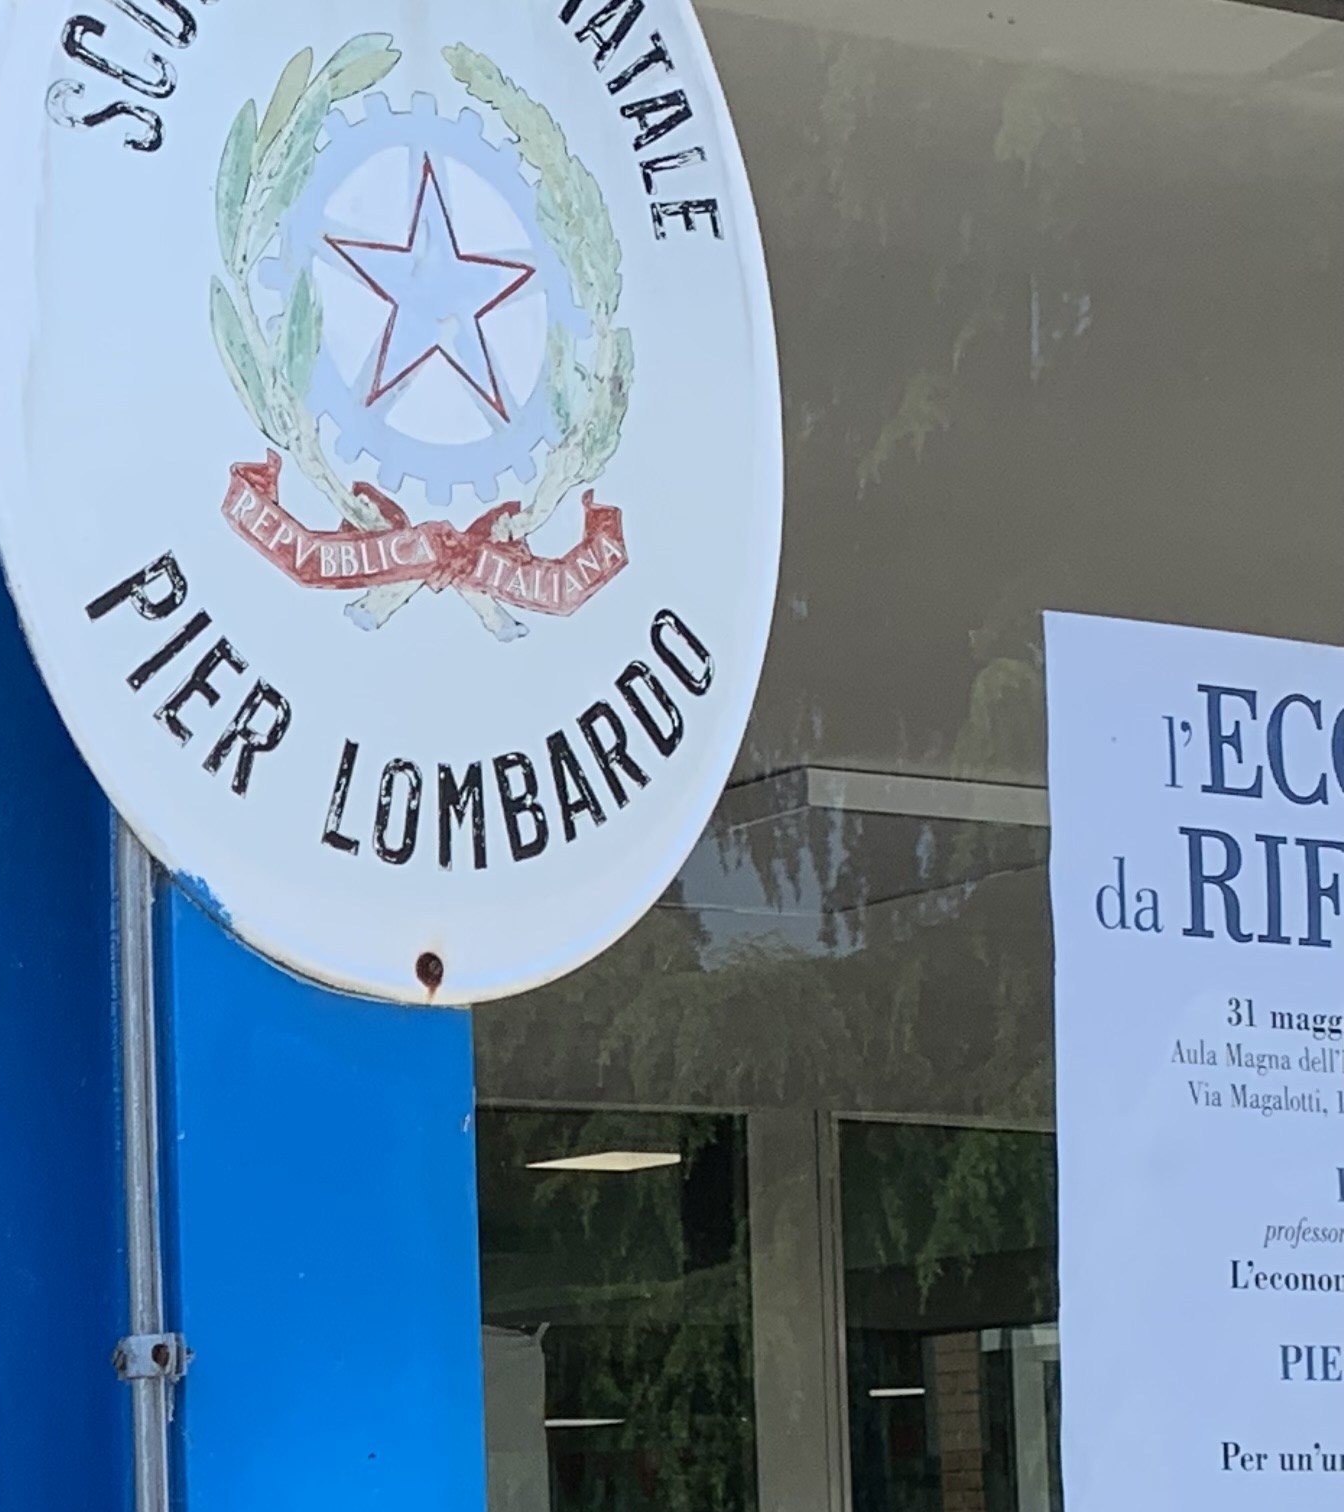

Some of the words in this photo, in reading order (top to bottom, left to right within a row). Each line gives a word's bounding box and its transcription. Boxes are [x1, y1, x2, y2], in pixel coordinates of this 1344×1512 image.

[559, 0, 724, 240] ATALE
[229, 488, 437, 579] REPVBBLICA
[475, 537, 624, 604] ITALIANA
[84, 549, 293, 798] PIER
[320, 607, 716, 873] LOMBARDO
[1161, 683, 1344, 805] l'EC
[1096, 857, 1164, 934] da
[1179, 826, 1344, 948] RIF
[1171, 1039, 1217, 1066] Aula
[1226, 1043, 1291, 1076] Magna
[1227, 997, 1256, 1027] 31
[1270, 1010, 1342, 1041] magg
[1188, 1081, 1222, 1107] Via
[1231, 1083, 1328, 1117] Magalotti,
[1280, 1344, 1342, 1381] PIE
[1220, 1441, 1268, 1471] Per
